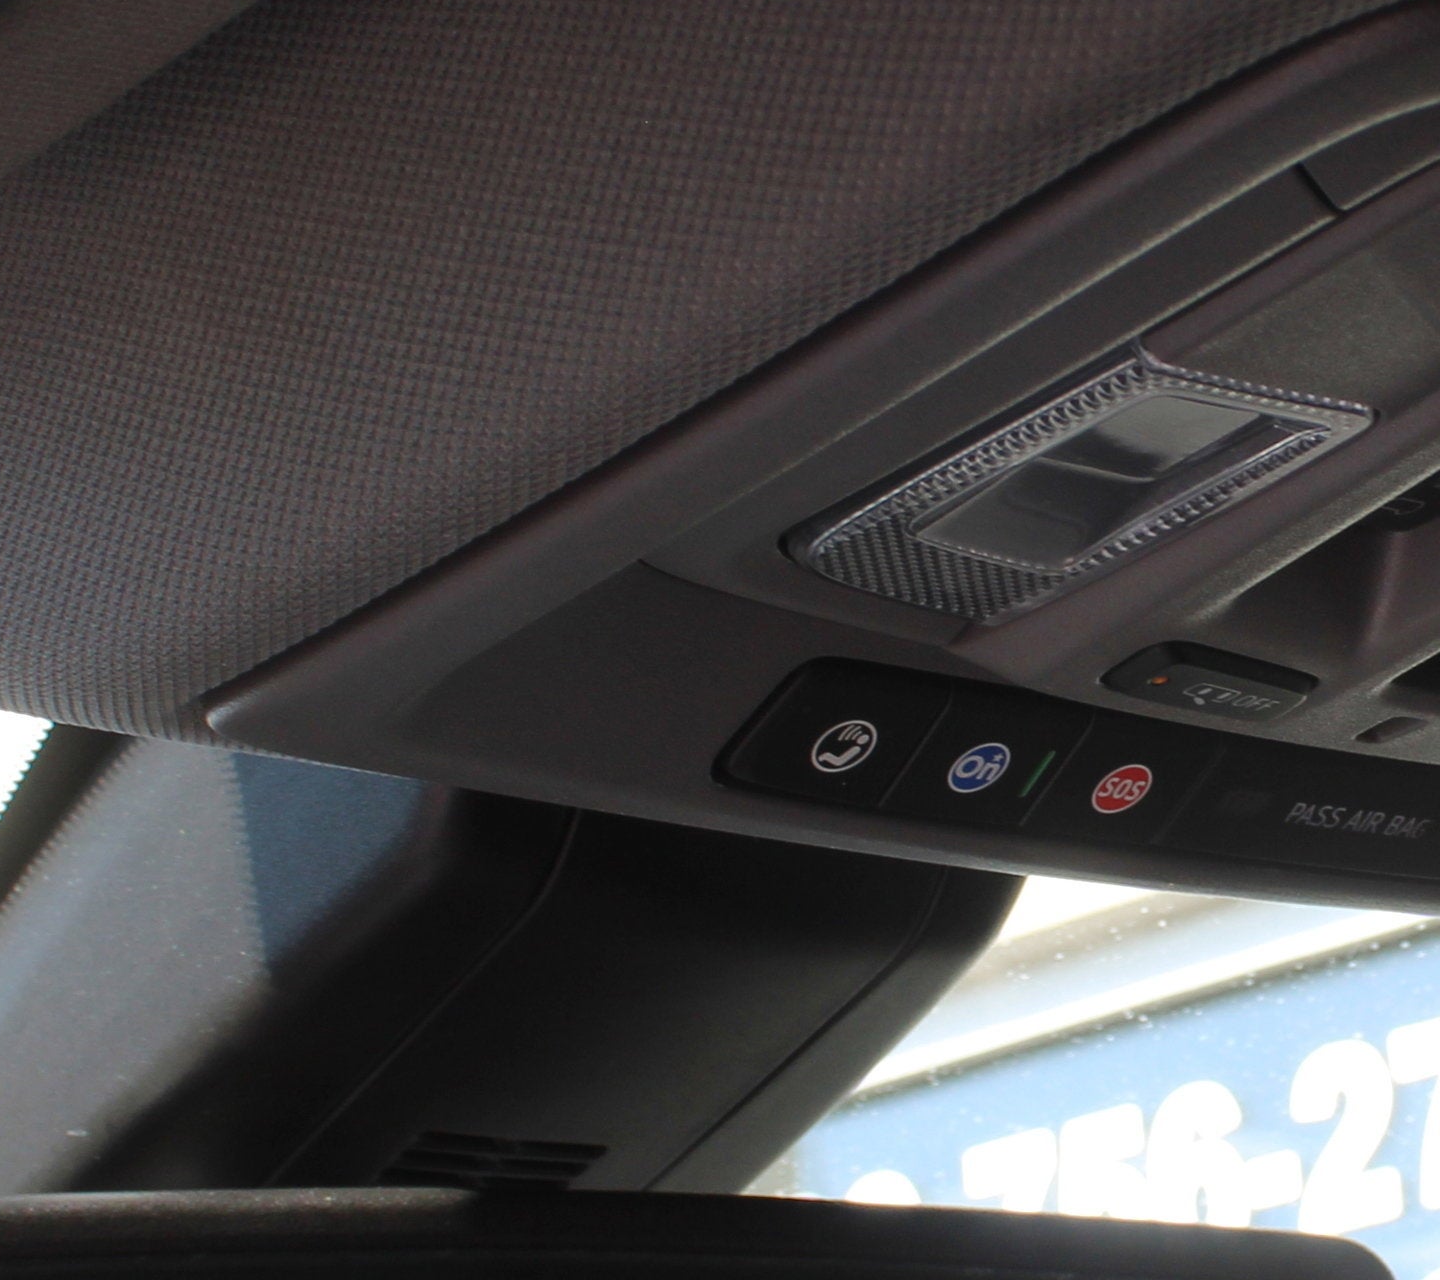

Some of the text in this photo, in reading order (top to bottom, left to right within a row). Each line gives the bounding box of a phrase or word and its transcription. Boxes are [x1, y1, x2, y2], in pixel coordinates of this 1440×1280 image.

[1234, 693, 1282, 714] OFF
[1097, 775, 1146, 803] SOS
[1283, 801, 1348, 830] PASS
[1343, 810, 1381, 836] AIR
